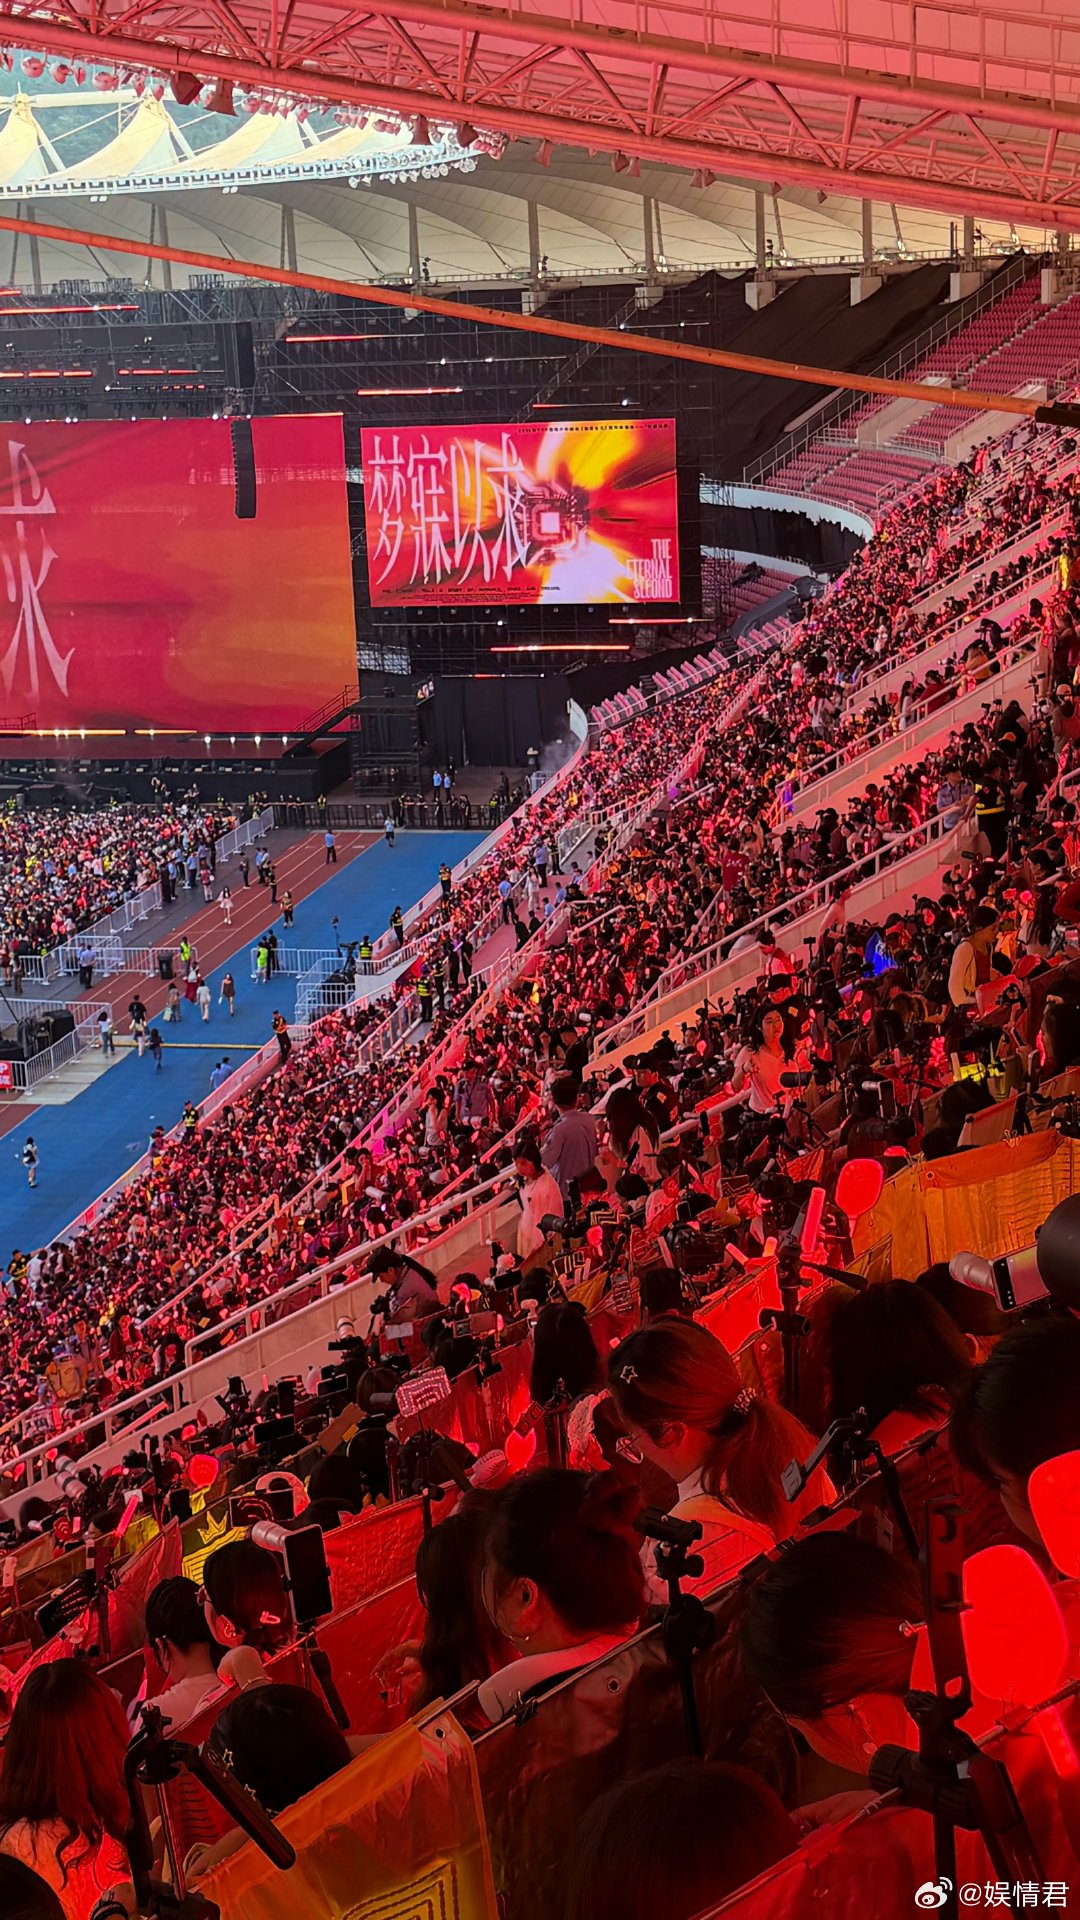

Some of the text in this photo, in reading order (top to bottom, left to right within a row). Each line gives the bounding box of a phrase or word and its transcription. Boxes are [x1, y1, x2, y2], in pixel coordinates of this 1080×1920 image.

[651, 539, 672, 558] THE
[626, 559, 673, 579] ETERNAL
[633, 579, 673, 598] SECOND
